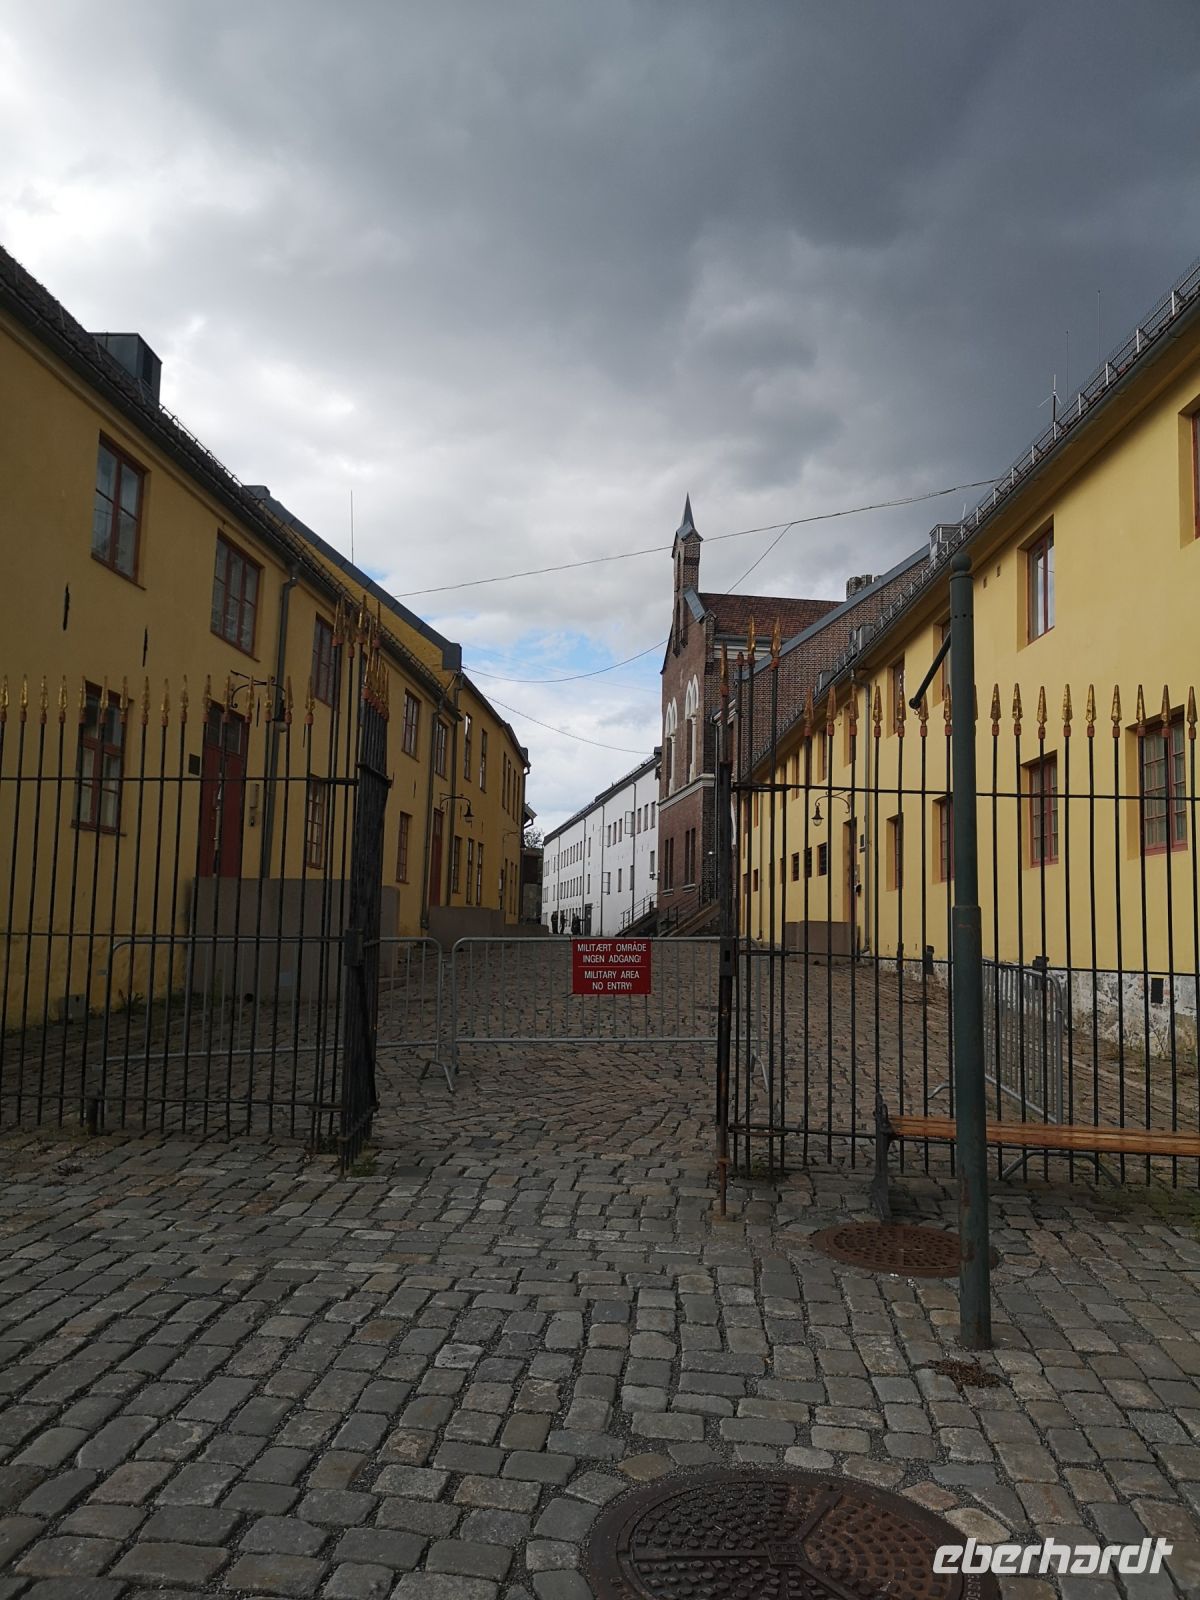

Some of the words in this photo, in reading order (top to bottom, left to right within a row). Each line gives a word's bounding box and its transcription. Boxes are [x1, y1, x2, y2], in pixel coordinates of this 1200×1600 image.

[577, 943, 612, 952] MILITÆRT
[616, 941, 647, 952] OMRÅDE
[583, 954, 605, 963] INGEN
[584, 970, 617, 979] MILITARY
[620, 970, 640, 979] AREA
[592, 981, 604, 990] NO
